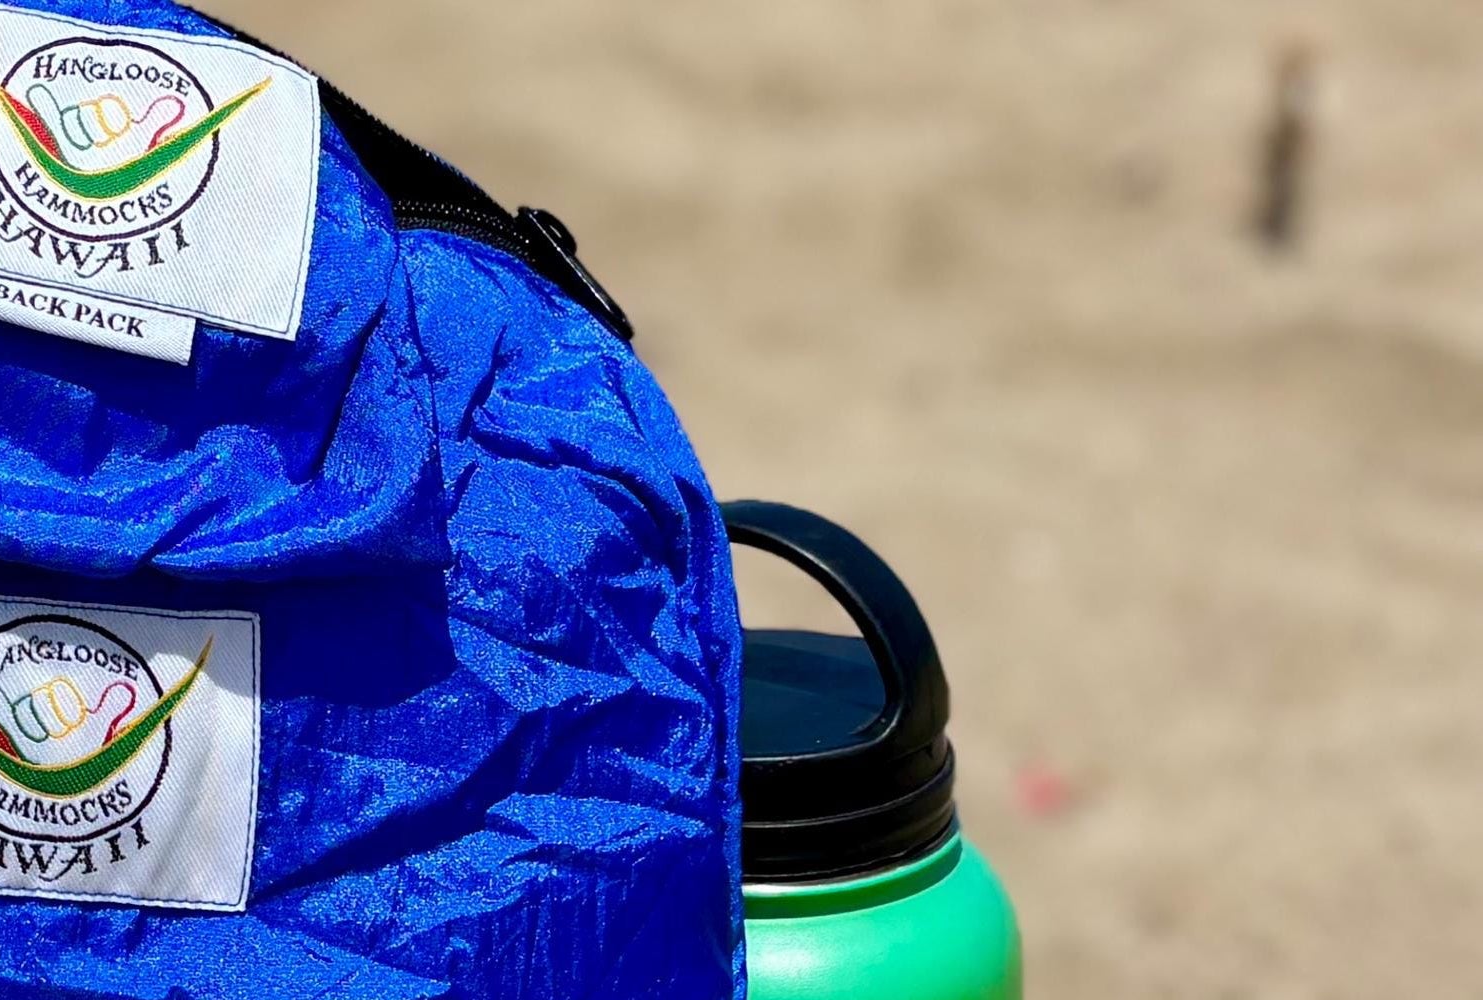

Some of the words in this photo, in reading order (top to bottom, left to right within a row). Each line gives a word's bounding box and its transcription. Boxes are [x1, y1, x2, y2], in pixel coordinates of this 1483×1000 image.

[32, 54, 192, 98] HANGLOOSE
[14, 161, 172, 226] HAMMOCKS
[74, 303, 147, 339] PACK
